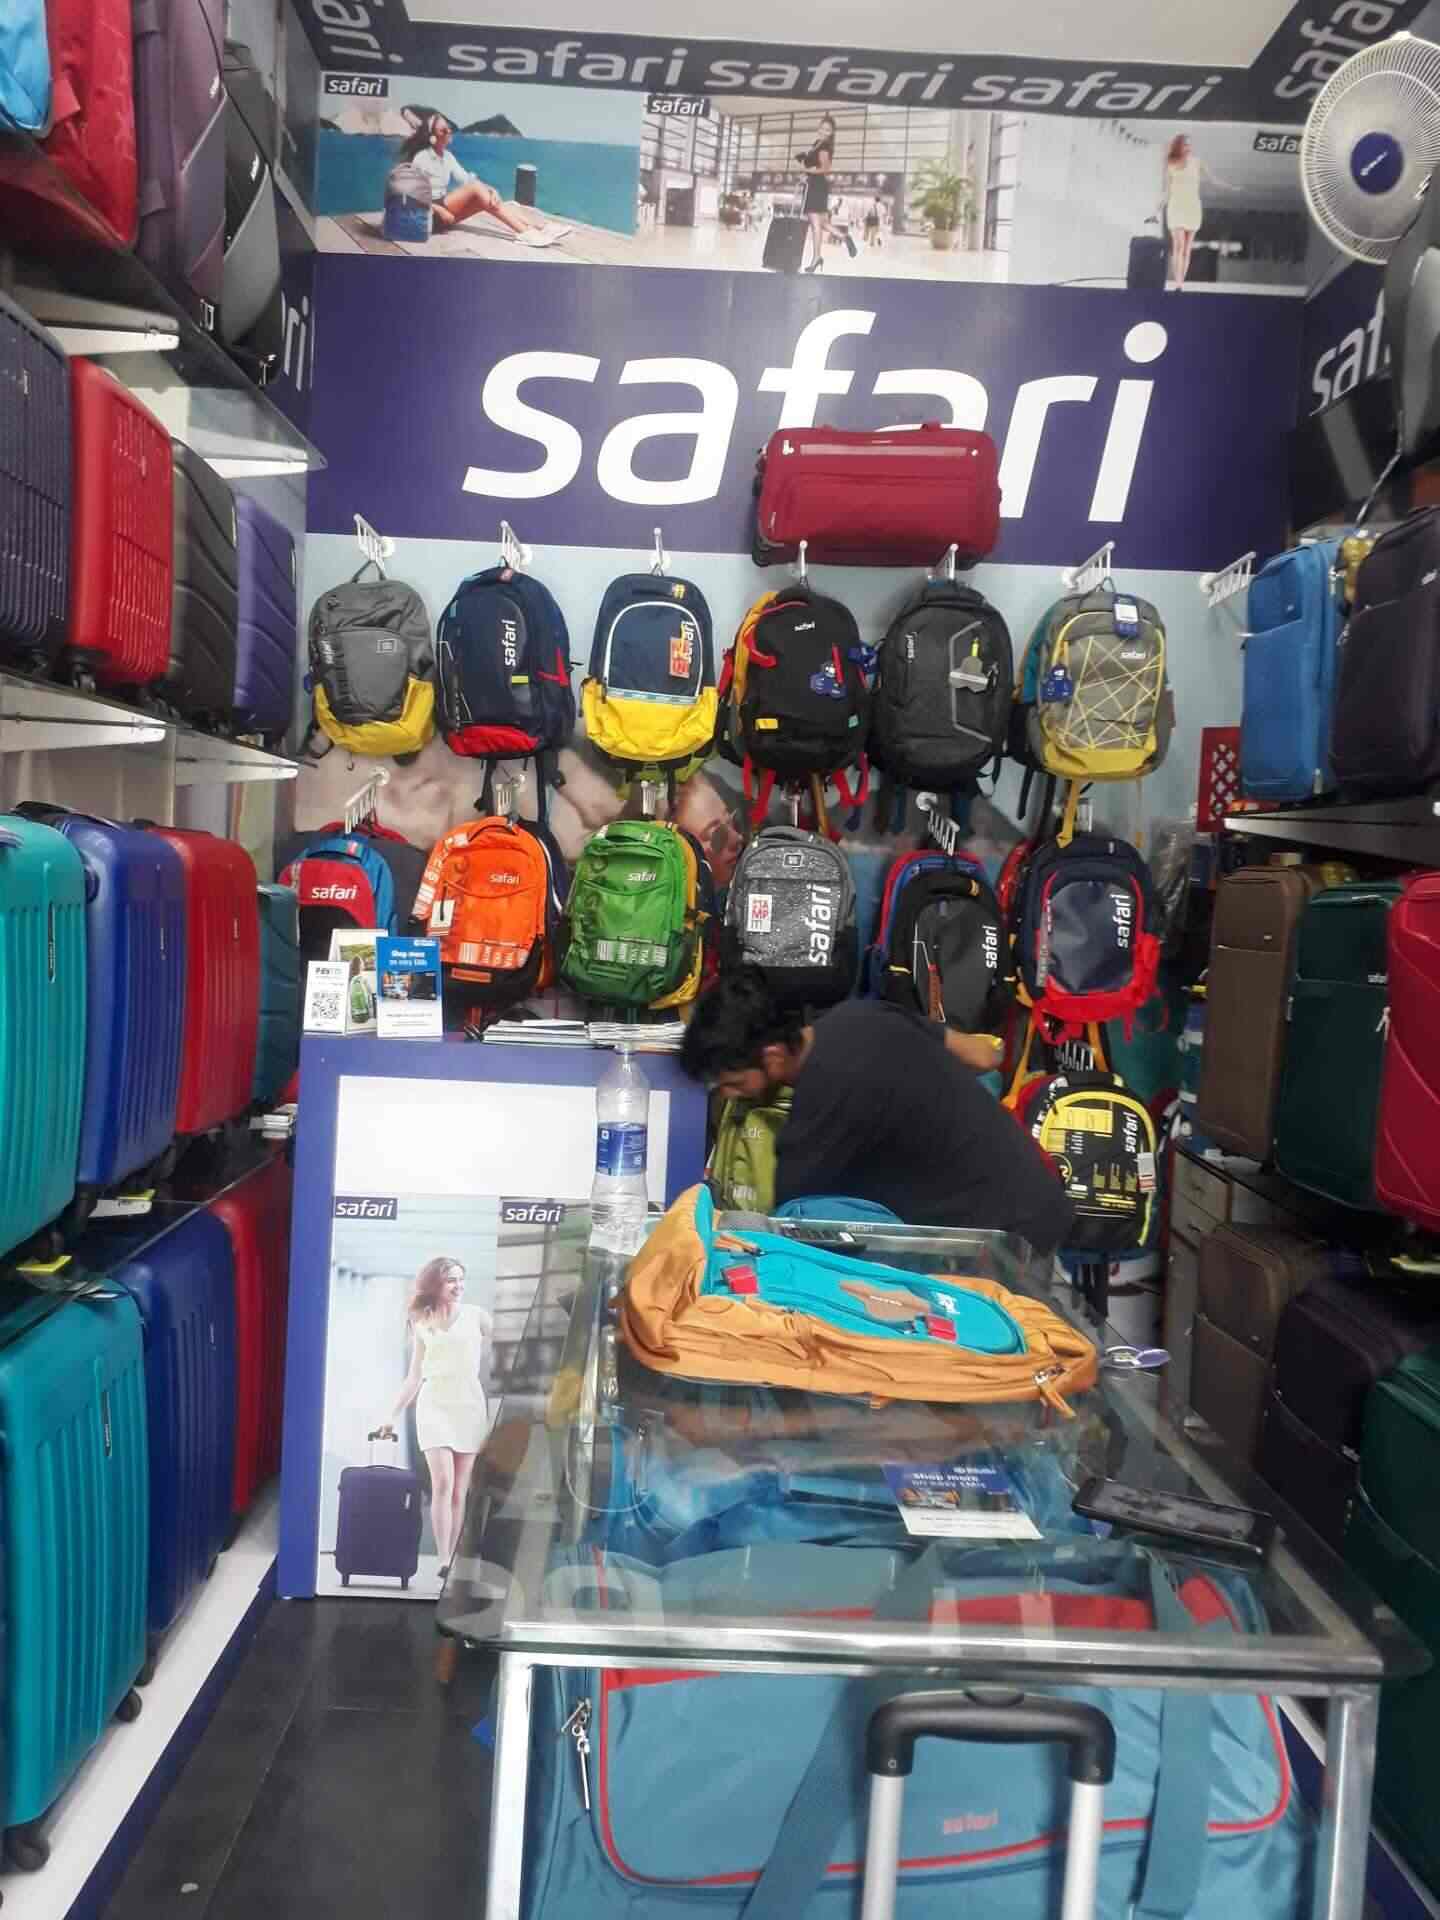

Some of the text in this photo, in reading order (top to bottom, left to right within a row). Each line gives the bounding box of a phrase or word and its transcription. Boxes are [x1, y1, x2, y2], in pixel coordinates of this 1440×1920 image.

[312, 0, 403, 63] ari
[1273, 0, 1396, 103] safa
[327, 77, 383, 95] safari
[447, 41, 1222, 113] safari safari safari
[651, 97, 705, 115] safari
[1255, 136, 1298, 152] safa
[501, 619, 517, 667] safari
[489, 873, 521, 885] safari
[628, 871, 657, 882] safari
[312, 884, 358, 900] safari
[806, 883, 832, 967] safari
[1110, 893, 1131, 949] safari
[981, 924, 998, 969] safari
[1121, 1111, 1138, 1153] safari
[336, 1199, 393, 1217] safari
[504, 1204, 561, 1222] safari
